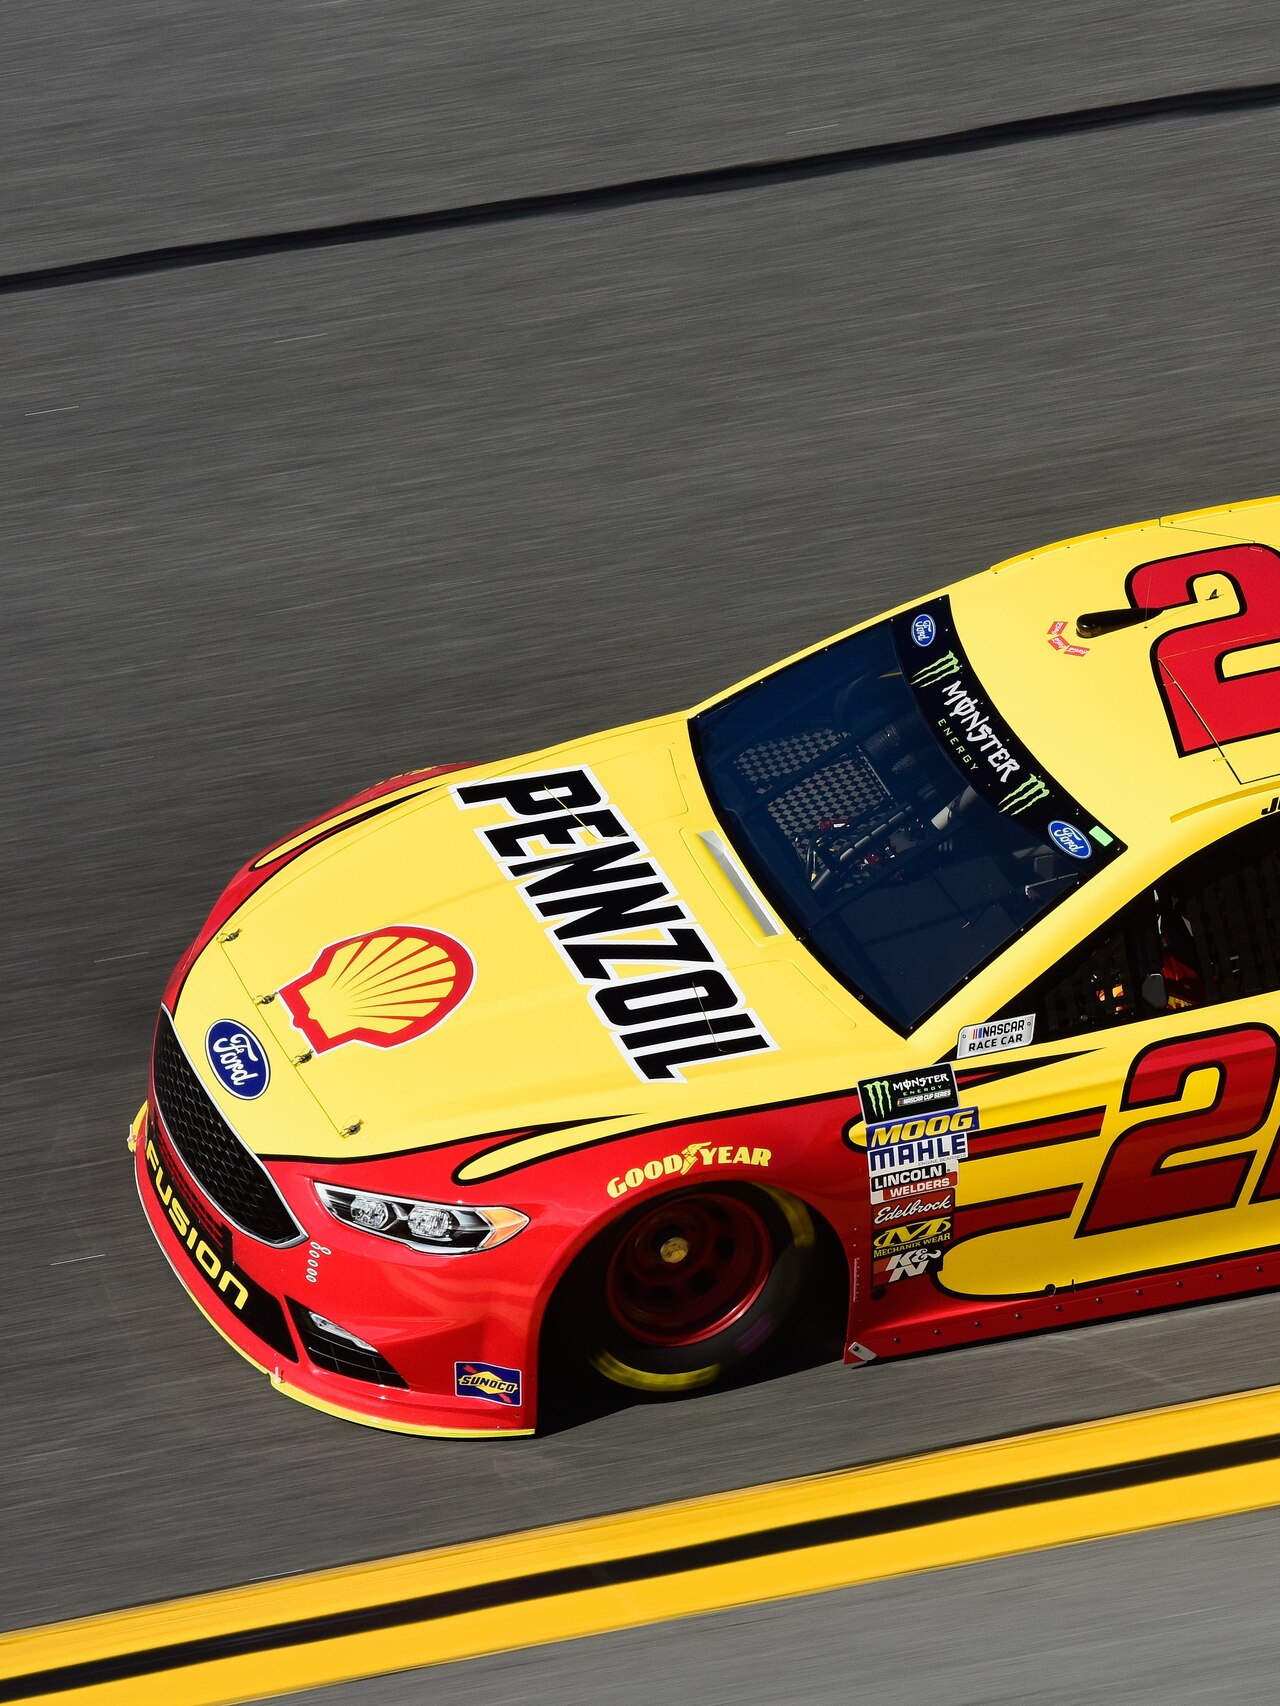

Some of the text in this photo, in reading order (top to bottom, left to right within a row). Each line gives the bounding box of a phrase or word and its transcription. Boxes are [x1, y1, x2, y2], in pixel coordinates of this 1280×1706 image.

[938, 718, 979, 771] ENERGY
[942, 681, 1020, 783] MONSTER
[452, 767, 775, 1082] PENNZOIL
[983, 1020, 1025, 1038] NASCAR
[969, 1034, 1023, 1051] RACE CAR
[892, 1073, 949, 1091] MONSTER
[903, 1085, 942, 1096] ENERGY
[871, 1110, 974, 1147] MOOG
[869, 1134, 966, 1172] MAHLE
[875, 1165, 942, 1189] LINCOLN
[890, 1178, 950, 1197] WELDERS
[874, 1195, 951, 1224] Edelbrock
[146, 1140, 249, 1310] FUSION
[874, 1233, 951, 1258] MECHANIX WEAR
[459, 1373, 518, 1395] SUNOCO
